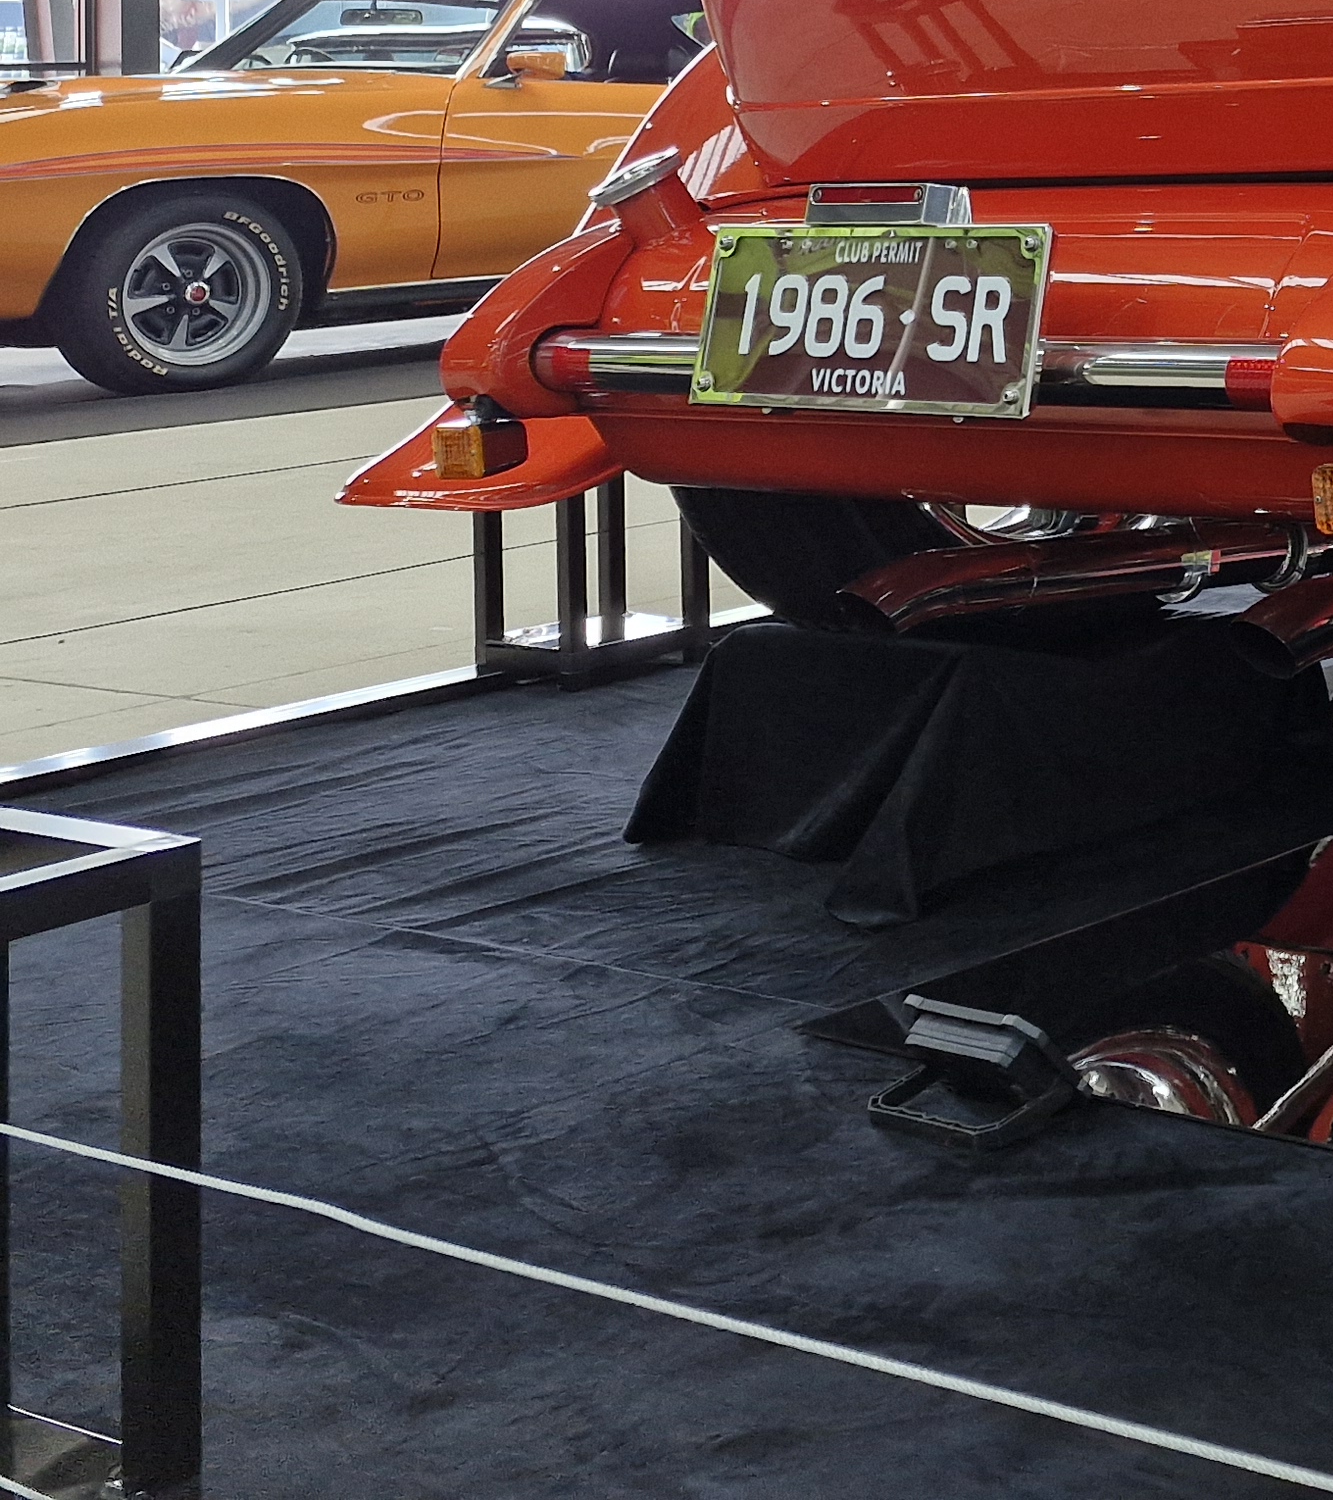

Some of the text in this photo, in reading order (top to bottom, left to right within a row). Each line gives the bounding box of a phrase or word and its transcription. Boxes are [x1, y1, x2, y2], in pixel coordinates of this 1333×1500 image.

[355, 189, 425, 204] GTO
[223, 211, 292, 311] BFGoodrich
[835, 241, 924, 264] CLUB PERMIT
[106, 286, 169, 377] Radial T/A
[926, 275, 1012, 364] SR
[811, 367, 907, 396] VICTORIA
